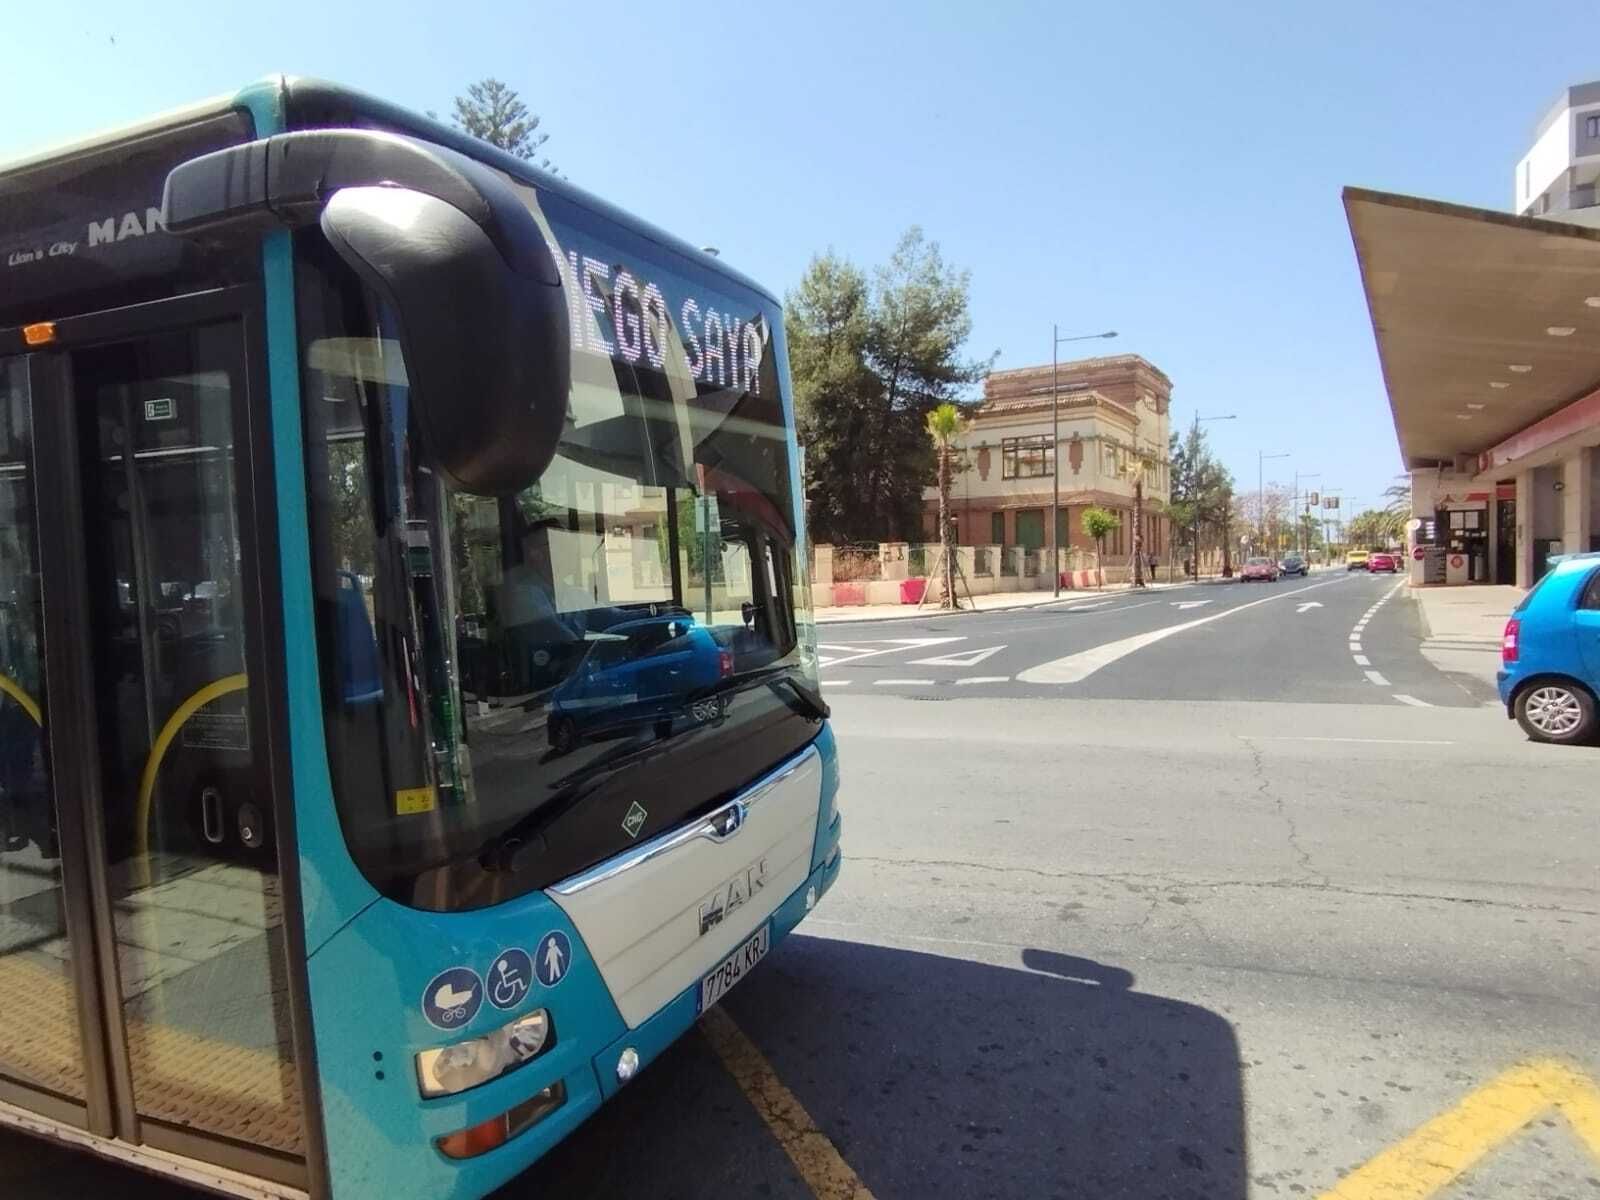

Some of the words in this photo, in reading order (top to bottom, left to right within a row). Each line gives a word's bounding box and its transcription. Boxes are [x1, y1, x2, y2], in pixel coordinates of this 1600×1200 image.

[48, 241, 79, 257] City
[88, 207, 165, 247] MAN
[697, 860, 769, 936] MAN
[706, 958, 741, 1003] 7784
[744, 928, 768, 966] KRJ
